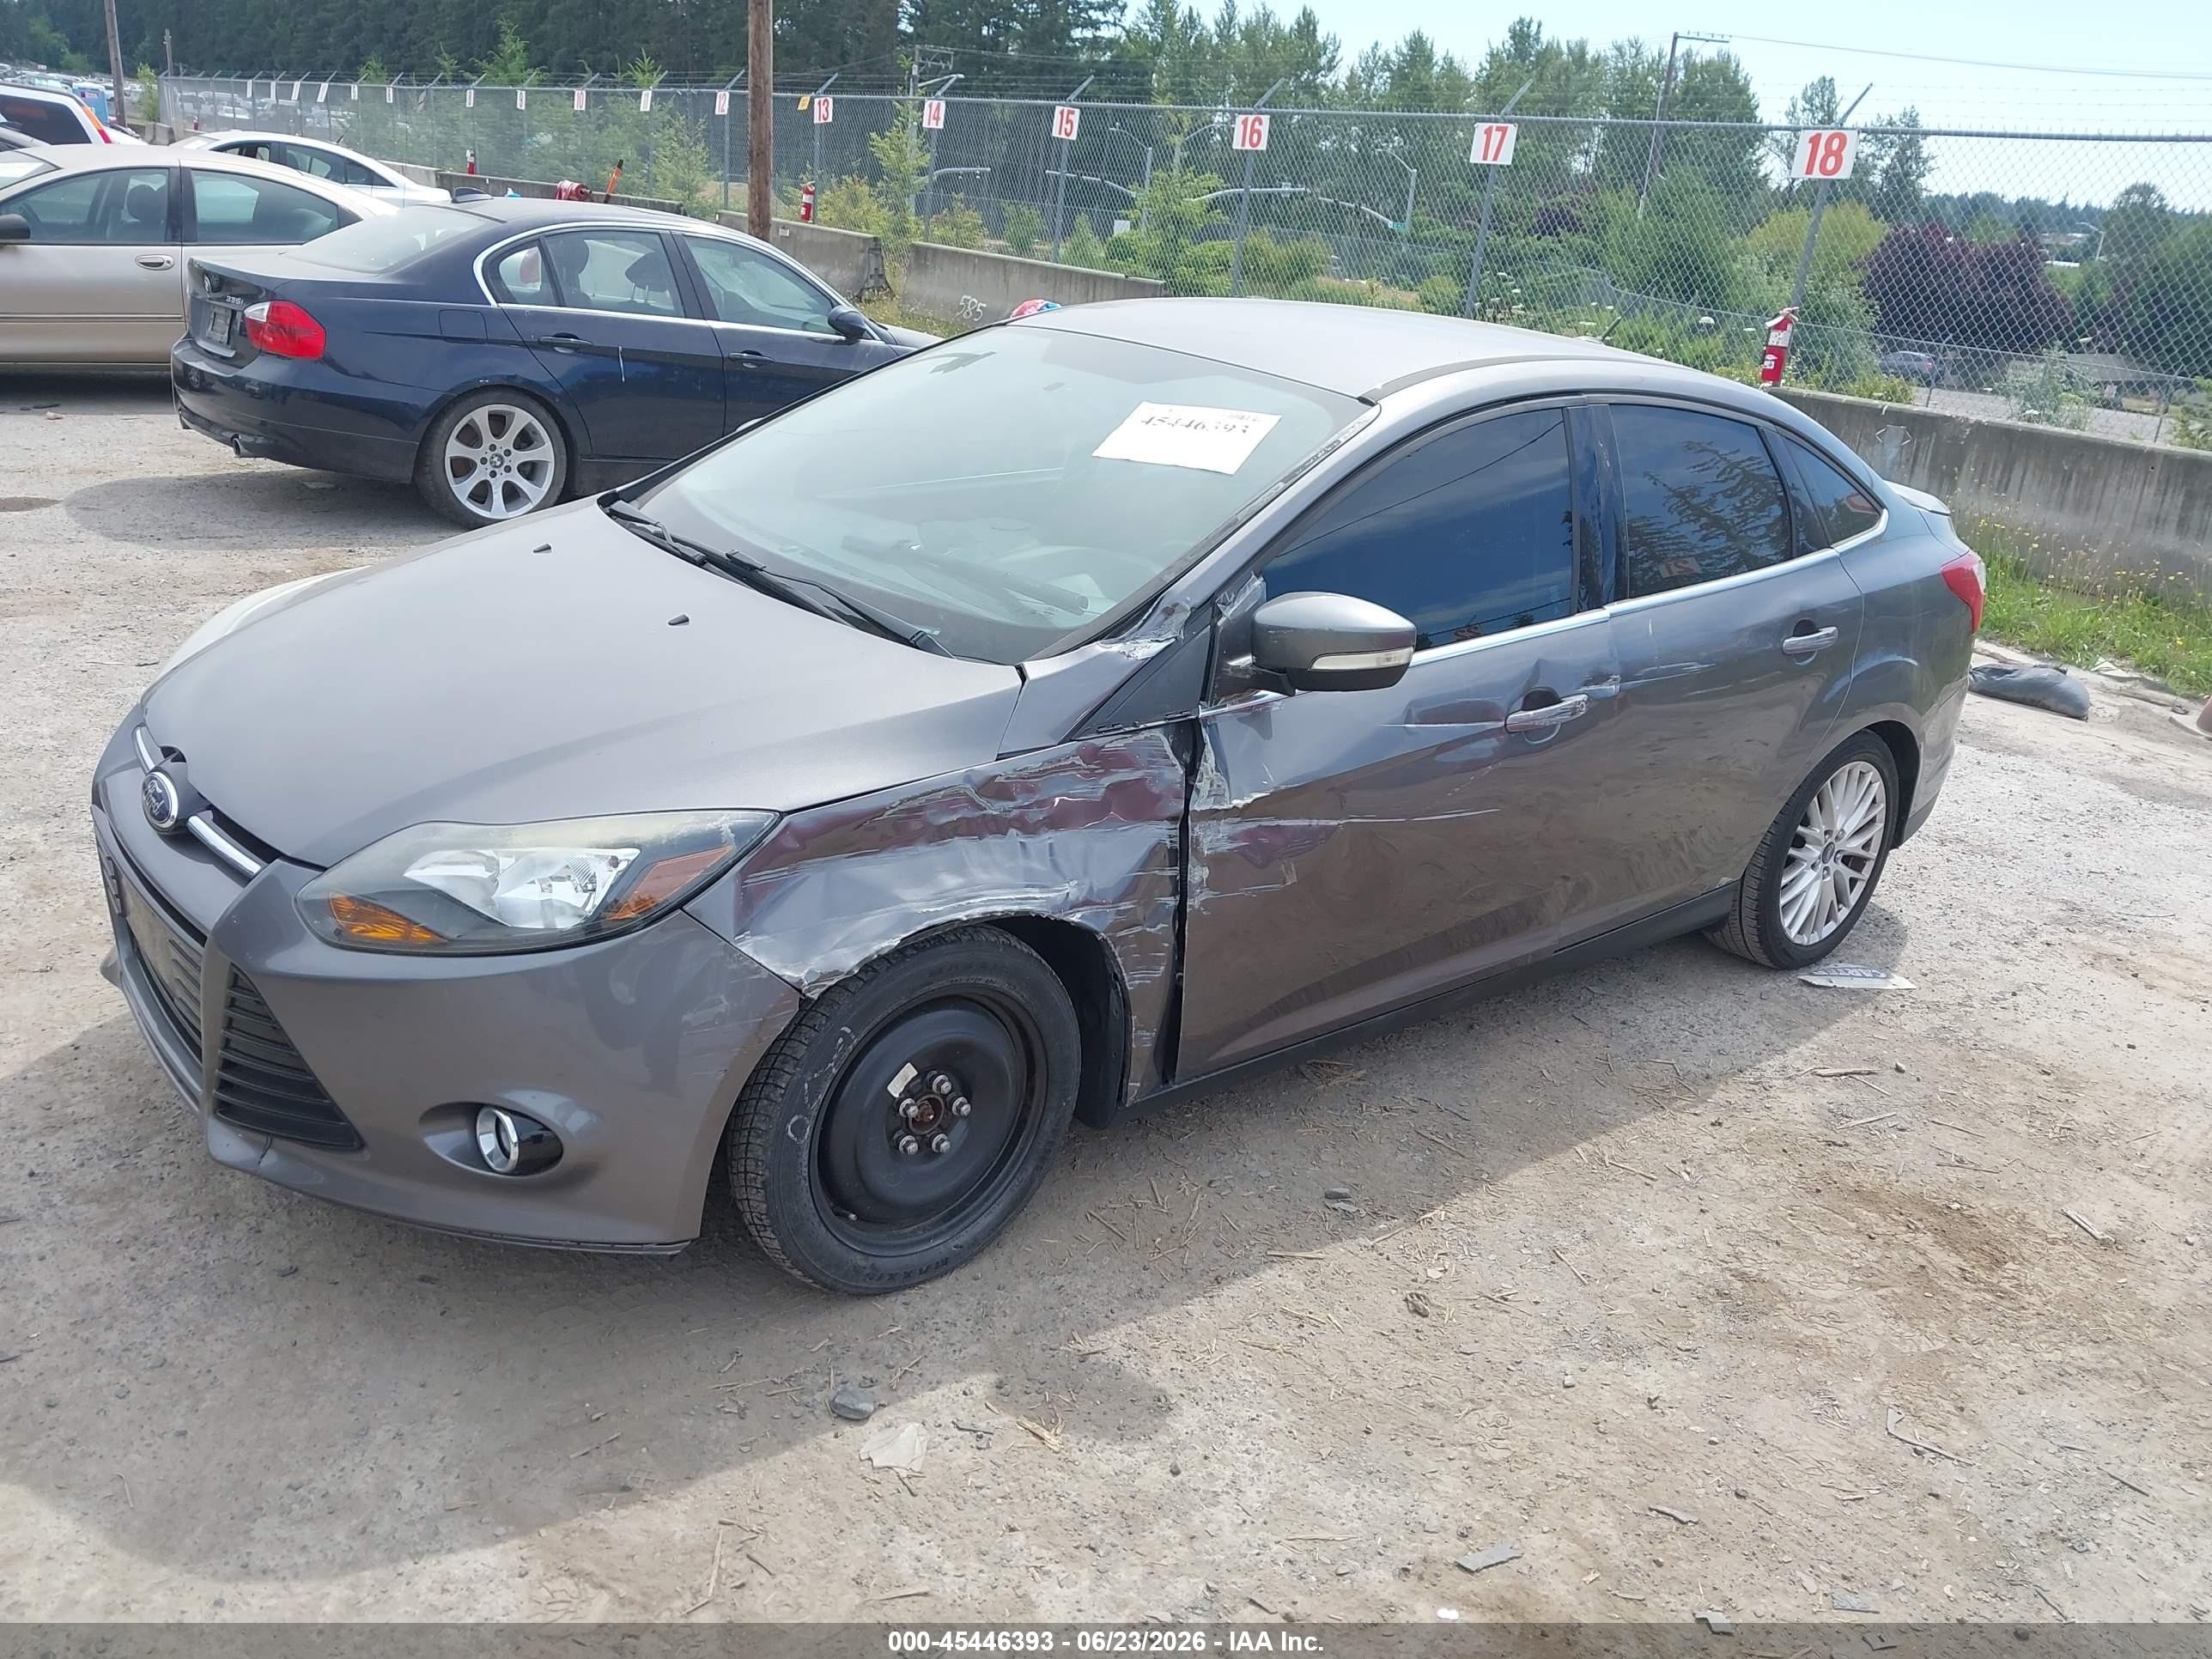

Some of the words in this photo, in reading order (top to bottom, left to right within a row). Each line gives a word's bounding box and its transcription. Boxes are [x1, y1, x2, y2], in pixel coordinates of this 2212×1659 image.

[576, 90, 585, 108] 10
[719, 92, 726, 112] 12
[817, 98, 830, 121] 13
[927, 101, 941, 126] 14
[1057, 107, 1076, 137] 15
[1241, 116, 1263, 148] 16
[1482, 125, 1509, 161] 17
[1805, 131, 1847, 176] 18
[956, 295, 987, 321] 585
[143, 779, 165, 817] Ford
